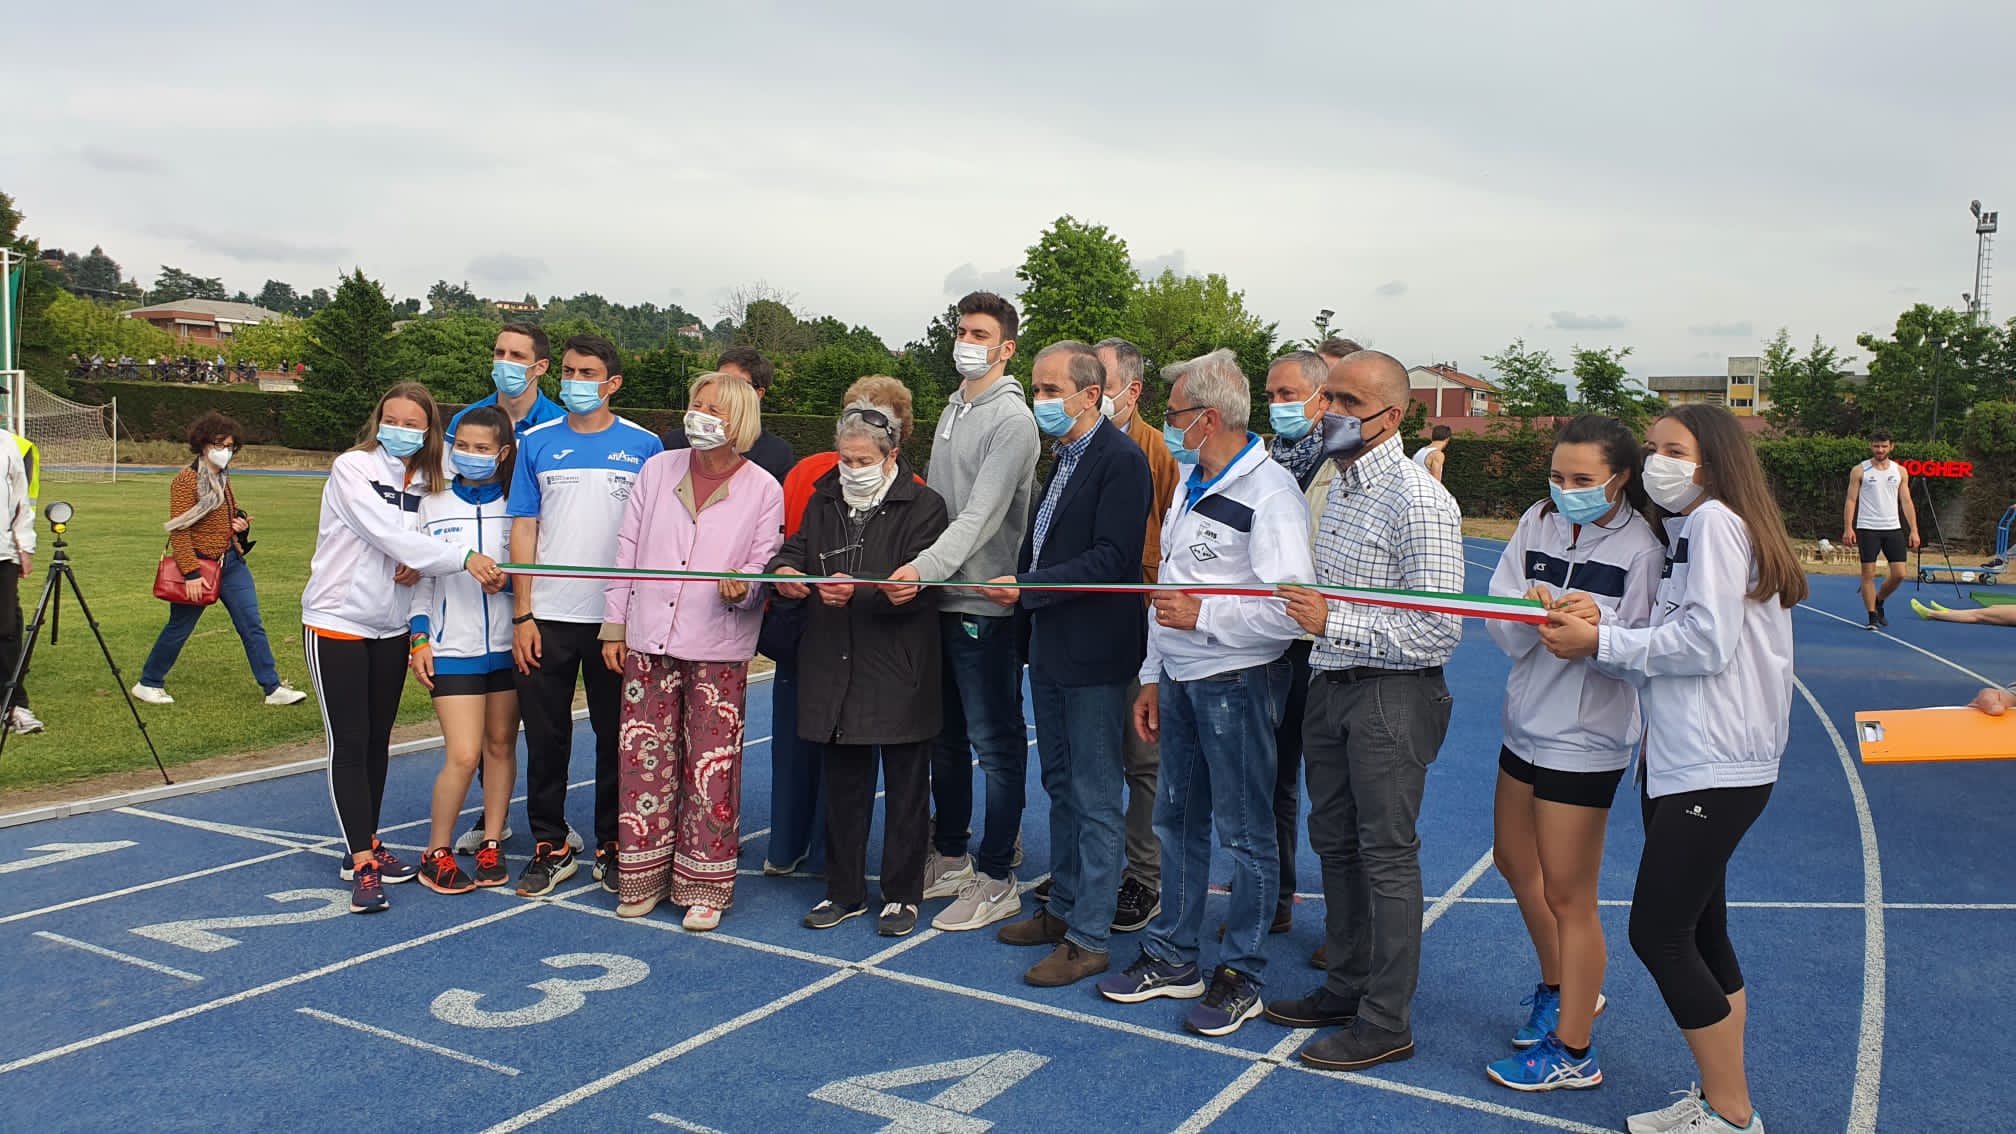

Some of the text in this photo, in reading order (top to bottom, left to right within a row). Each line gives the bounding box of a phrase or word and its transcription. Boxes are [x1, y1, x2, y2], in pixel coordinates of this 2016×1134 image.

[128, 888, 353, 952] 2
[430, 952, 650, 1028] 3
[808, 1049, 1051, 1134] 4
